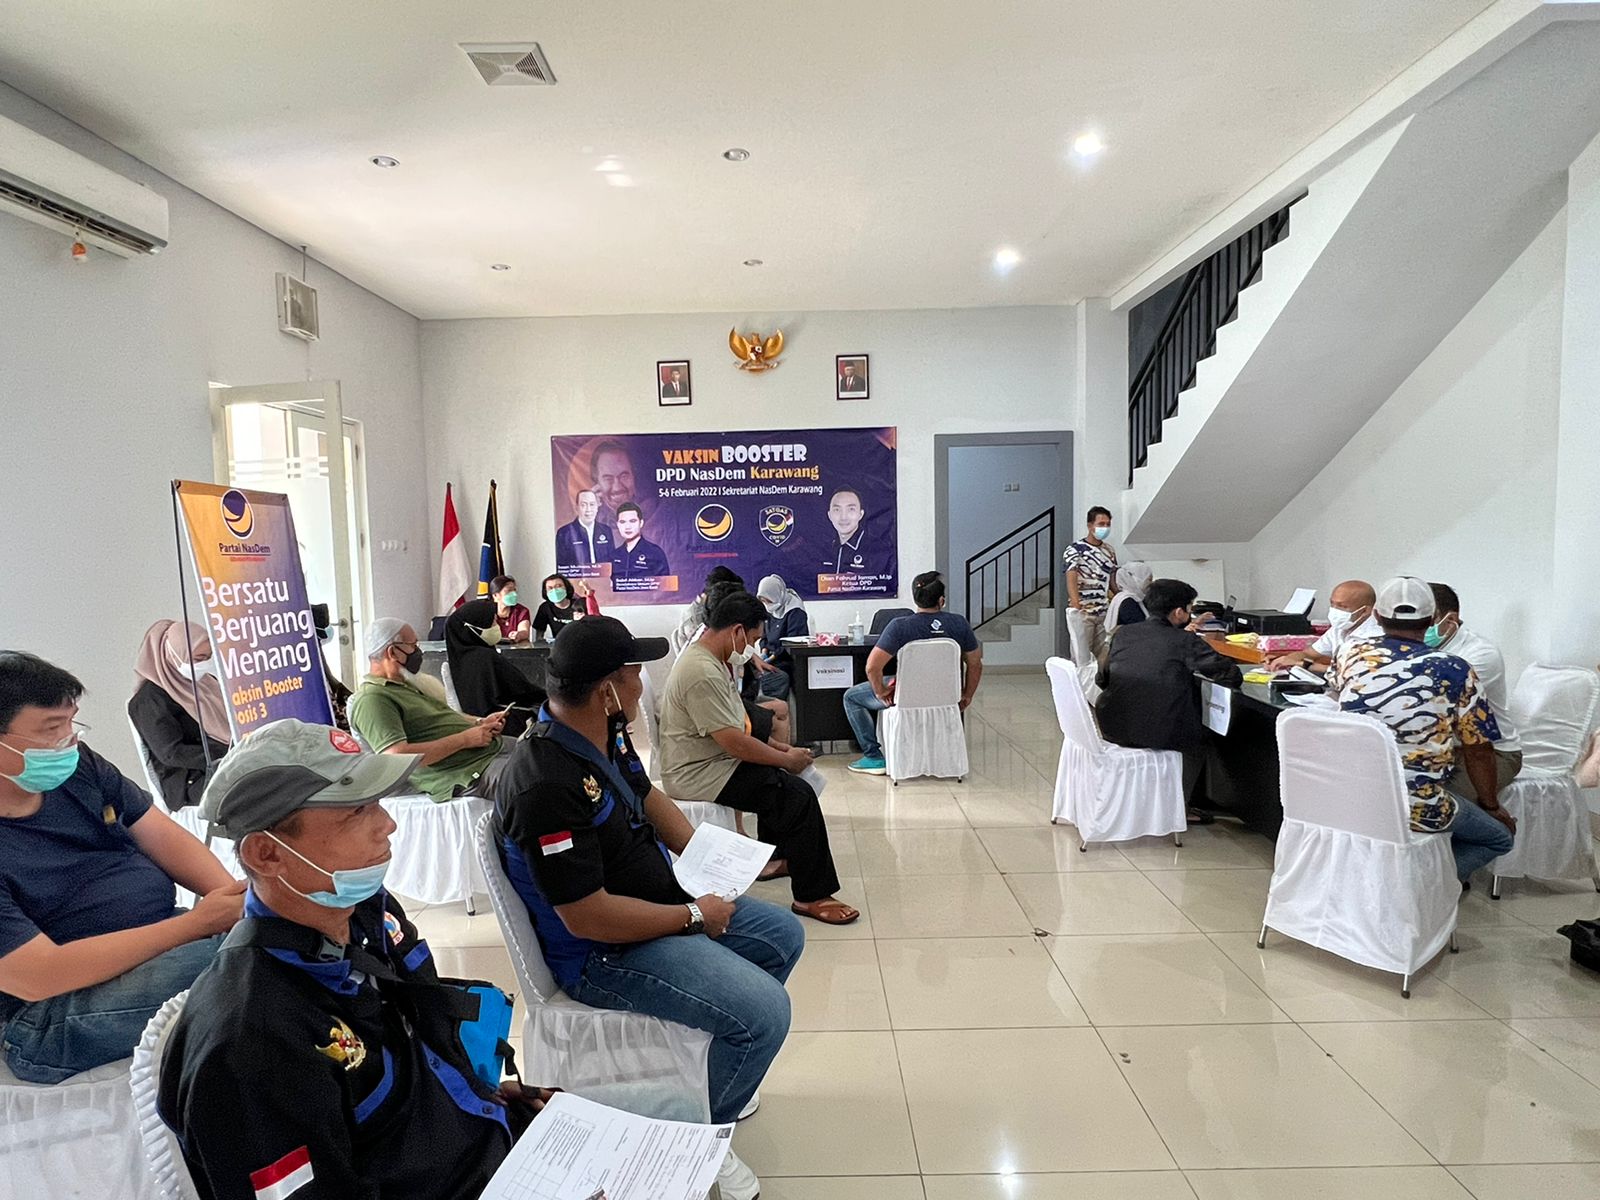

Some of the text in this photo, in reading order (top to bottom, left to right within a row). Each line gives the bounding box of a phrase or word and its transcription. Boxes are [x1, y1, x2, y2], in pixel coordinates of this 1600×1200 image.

[662, 444, 807, 465] VAKSIN BOOSTER
[656, 465, 820, 482] DPD NasDem Karawang
[659, 487, 670, 497] 5-6
[671, 487, 699, 497] Februari
[700, 486, 717, 496] 2022
[722, 486, 758, 496] Sekretariat
[759, 485, 787, 495] NasDem
[788, 484, 823, 496] Karawang
[765, 507, 788, 515] SATGAS
[219, 542, 271, 553] Partai NasDem
[202, 577, 289, 608] Bersatu
[210, 609, 314, 648] Berjuang
[232, 676, 303, 706] aksin Booster
[234, 702, 268, 725] osis 3
